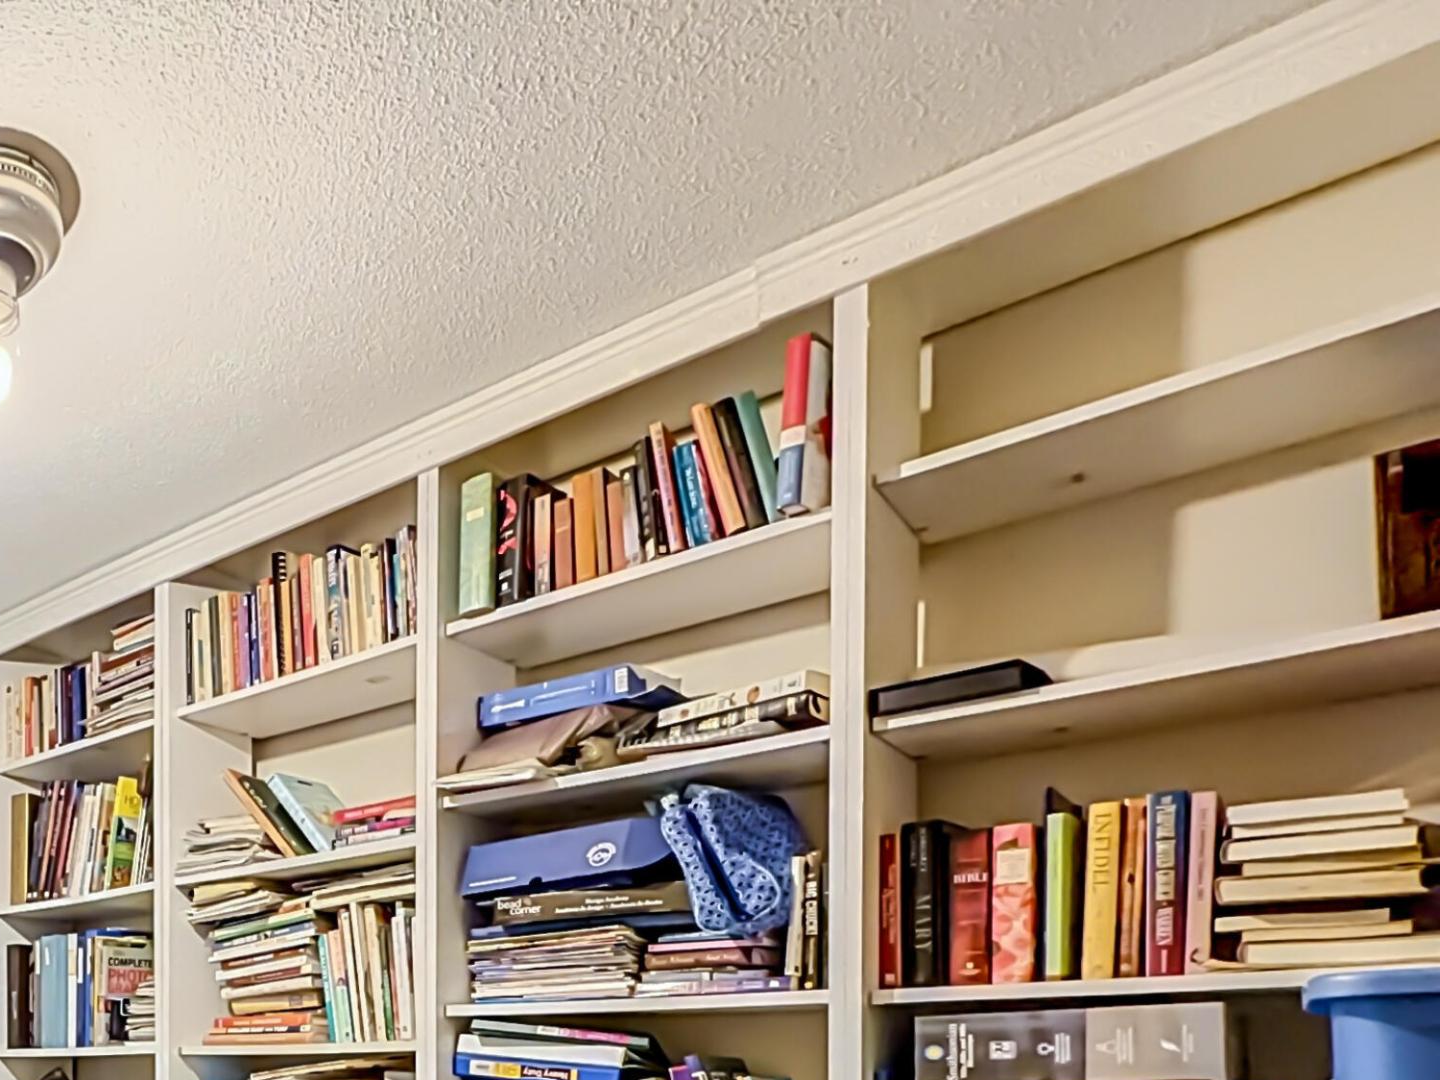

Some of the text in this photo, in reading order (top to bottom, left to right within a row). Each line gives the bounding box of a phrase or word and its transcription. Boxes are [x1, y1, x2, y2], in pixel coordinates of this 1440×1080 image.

[1091, 812, 1112, 892] INFIDEL
[953, 872, 988, 884] BIBLE
[497, 899, 522, 910] bead
[510, 904, 542, 915] corner
[915, 895, 932, 951] MARY
[108, 957, 153, 968] COMPLETE
